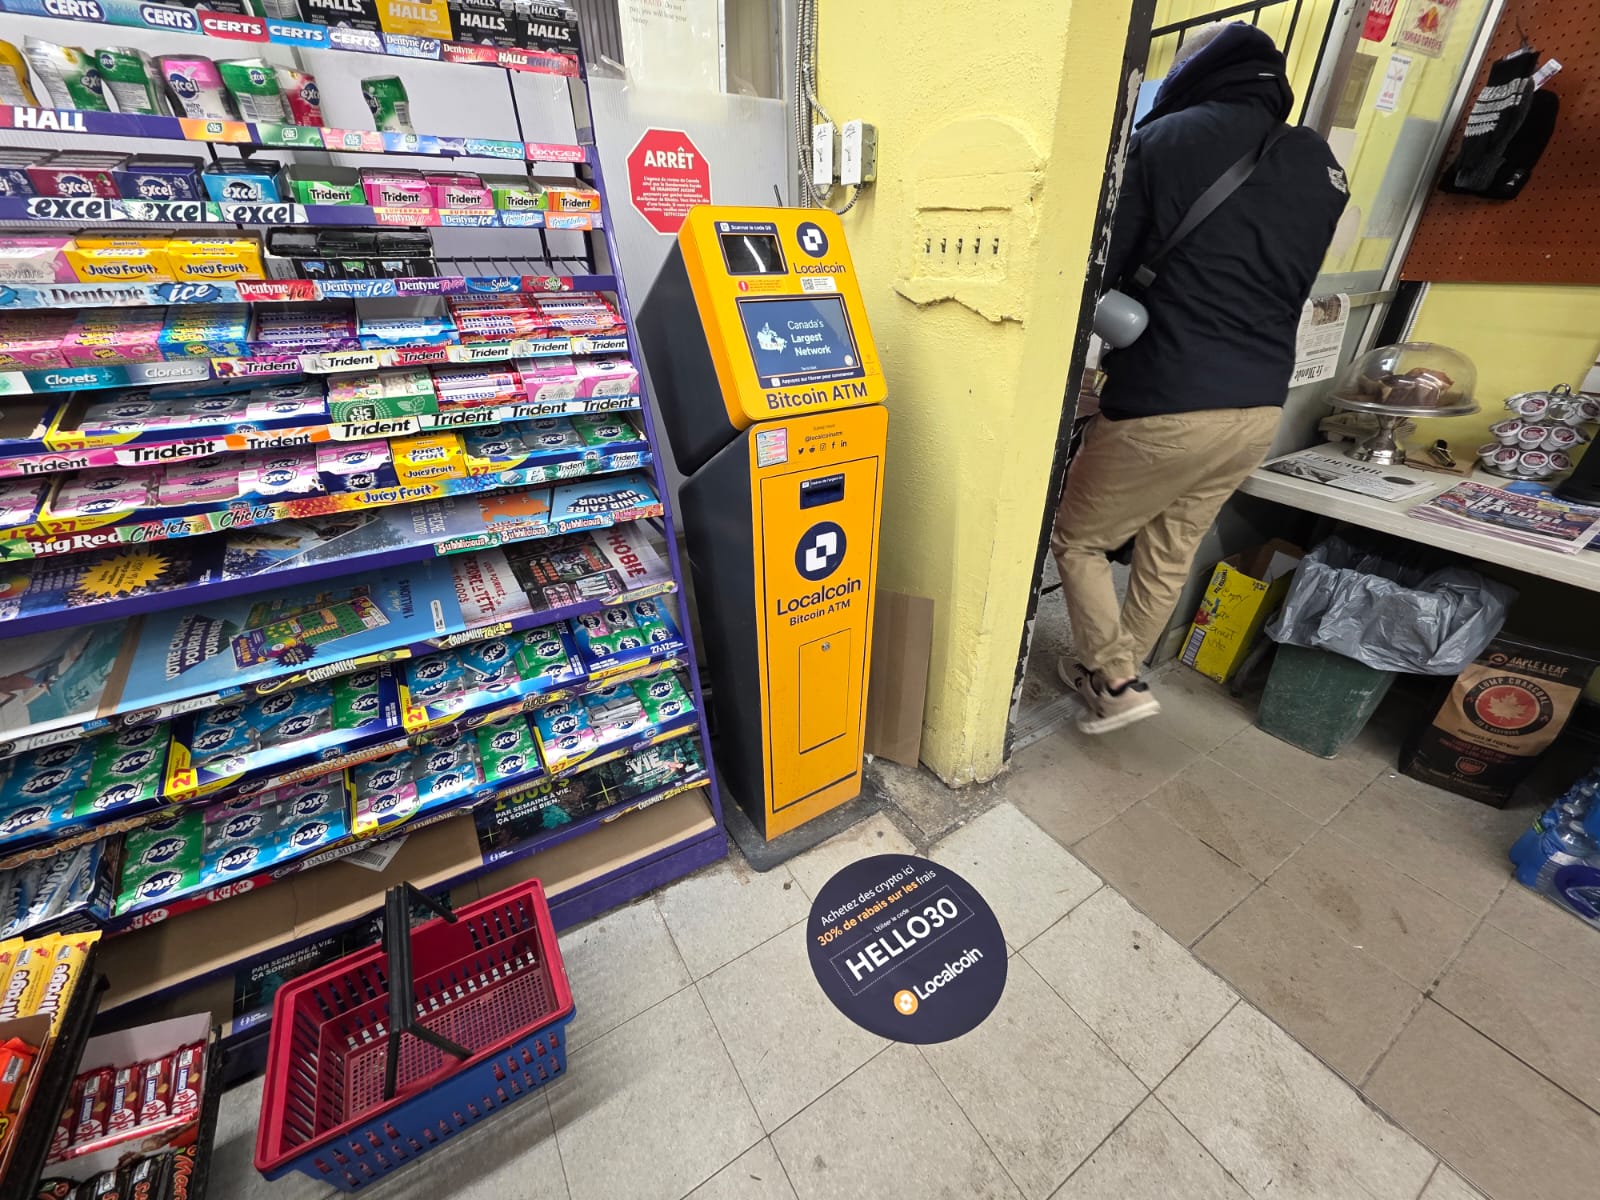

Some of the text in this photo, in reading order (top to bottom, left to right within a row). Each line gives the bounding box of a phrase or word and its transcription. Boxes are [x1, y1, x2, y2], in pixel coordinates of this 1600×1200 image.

[142, 7, 195, 30] CERTS
[203, 18, 262, 35] CERTS
[269, 25, 323, 41] CERTS
[330, 32, 379, 47] CERTS
[386, 34, 419, 49] Dentyne
[443, 43, 475, 56] Dentyne
[498, 52, 528, 65] HALLS
[643, 146, 695, 170] ARRÊT
[60, 180, 94, 195] excel
[140, 184, 173, 197] excel
[223, 184, 262, 201] excel
[309, 188, 351, 201] Trident
[382, 191, 420, 204] Trident
[446, 193, 481, 206] Trident
[506, 196, 539, 208] Trident
[560, 198, 591, 209] Trident
[34, 199, 112, 220] excel
[233, 202, 296, 223] excel
[446, 215, 477, 225] Dentyne
[88, 262, 154, 276] Juicy Fruit
[184, 262, 246, 277] Juicy Fruit
[793, 262, 847, 275] Localcoin
[240, 282, 288, 296] Dentyne
[322, 280, 393, 297] Dentyne ice
[400, 280, 440, 291] Dentyne
[53, 284, 211, 305] Dentyne ice
[787, 319, 824, 331] Canada's
[592, 340, 625, 351] Trident
[790, 333, 823, 344] Largest
[403, 349, 444, 362] Trident
[470, 346, 509, 358] Trident
[532, 342, 569, 353] Trident
[794, 345, 832, 357] Network
[246, 361, 297, 372] Trident
[328, 354, 374, 367] Trident
[46, 373, 97, 386] Clorets
[145, 366, 192, 379] Clorets
[766, 381, 868, 410] Bitcoin ATM
[511, 401, 566, 418] Trident
[582, 397, 635, 412] Trident
[431, 410, 494, 427] Trident
[342, 420, 411, 439] Trident
[246, 433, 311, 449] Trident
[129, 441, 215, 463] Trident
[612, 452, 639, 463] Trident
[19, 456, 88, 475] Trident
[405, 463, 453, 479] Juicy Fruit
[558, 460, 585, 472] Trident
[363, 484, 432, 503] Juicy Fruit
[566, 502, 606, 514] FAIRE
[220, 505, 276, 528] Chiclets
[49, 521, 76, 533] 27
[131, 520, 192, 543] Chiclets
[32, 536, 70, 554] Big
[777, 577, 862, 616] Localcoin
[789, 599, 852, 627] Bitcoin ATM
[306, 660, 357, 682] CARAMILK
[1542, 663, 1569, 675] LEAF
[1478, 677, 1504, 691] LUMP
[522, 694, 550, 710] FUDGE
[279, 714, 316, 736] excel
[194, 728, 234, 750] excel
[110, 750, 157, 772] excel
[551, 761, 568, 773] 27
[628, 753, 663, 775] VIE
[21, 769, 73, 792] excel
[94, 782, 144, 808] excel
[496, 808, 512, 819] PAR
[513, 796, 548, 814] SEMAINE
[512, 804, 540, 820] SONNE
[213, 880, 250, 900] KitKat
[820, 863, 916, 927] Achetez des crypto ici
[816, 868, 937, 947] 30% de rabais sur les frais
[844, 897, 959, 982] HELLO30
[251, 963, 270, 975] PAR
[271, 947, 311, 967] SEMAINE
[265, 959, 298, 976] SONNE
[912, 946, 985, 1001] Localcoin
